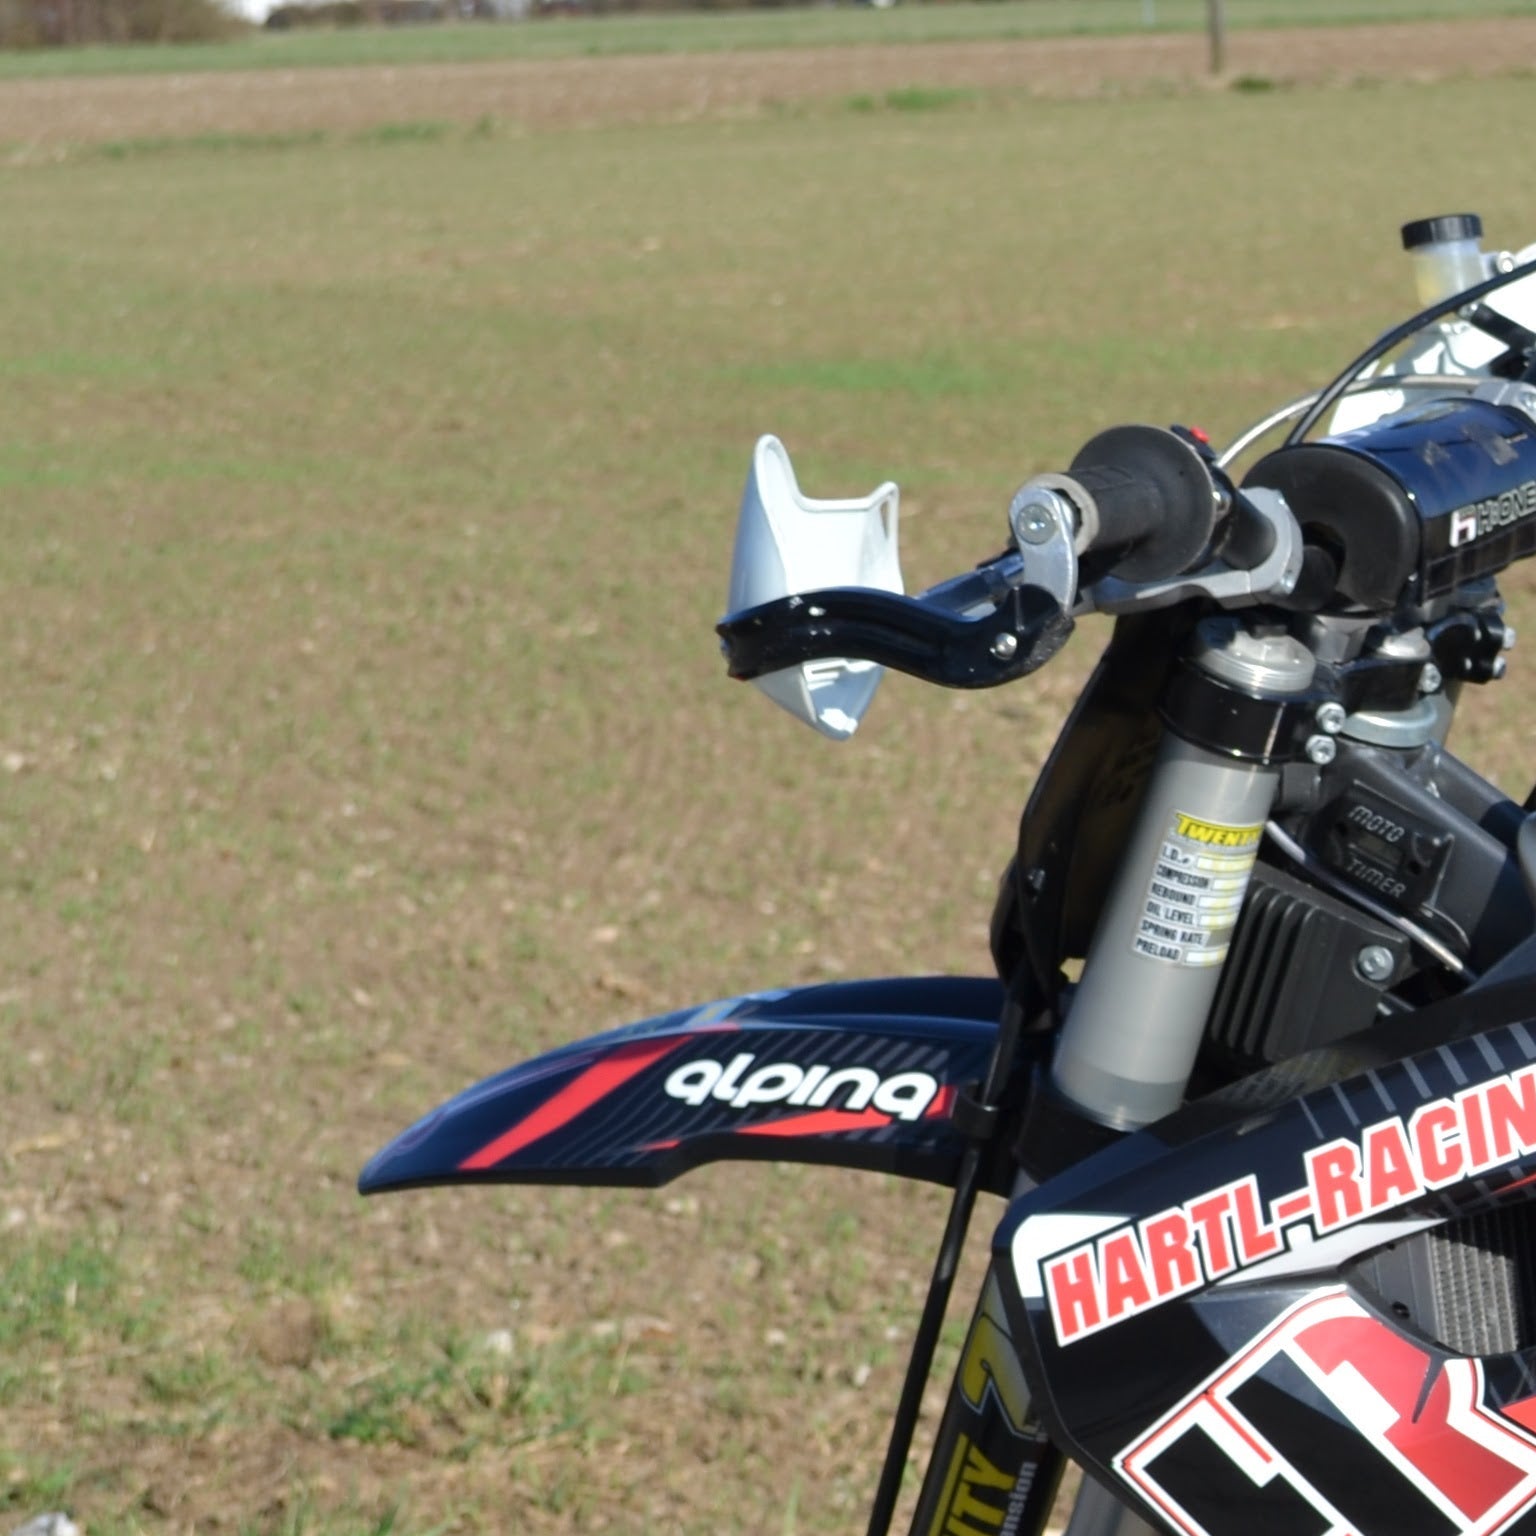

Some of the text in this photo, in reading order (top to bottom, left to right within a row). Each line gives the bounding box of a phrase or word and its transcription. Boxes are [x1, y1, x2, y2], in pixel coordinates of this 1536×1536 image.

[1348, 805, 1405, 843] MOTO
[1347, 857, 1406, 898] TIMER
[1152, 883, 1195, 906] REBOUND
[1165, 907, 1194, 924] LEVEL
[1141, 919, 1204, 947] SPRING RATE
[1136, 938, 1180, 960] PRELOAD
[664, 1053, 938, 1121] alpina
